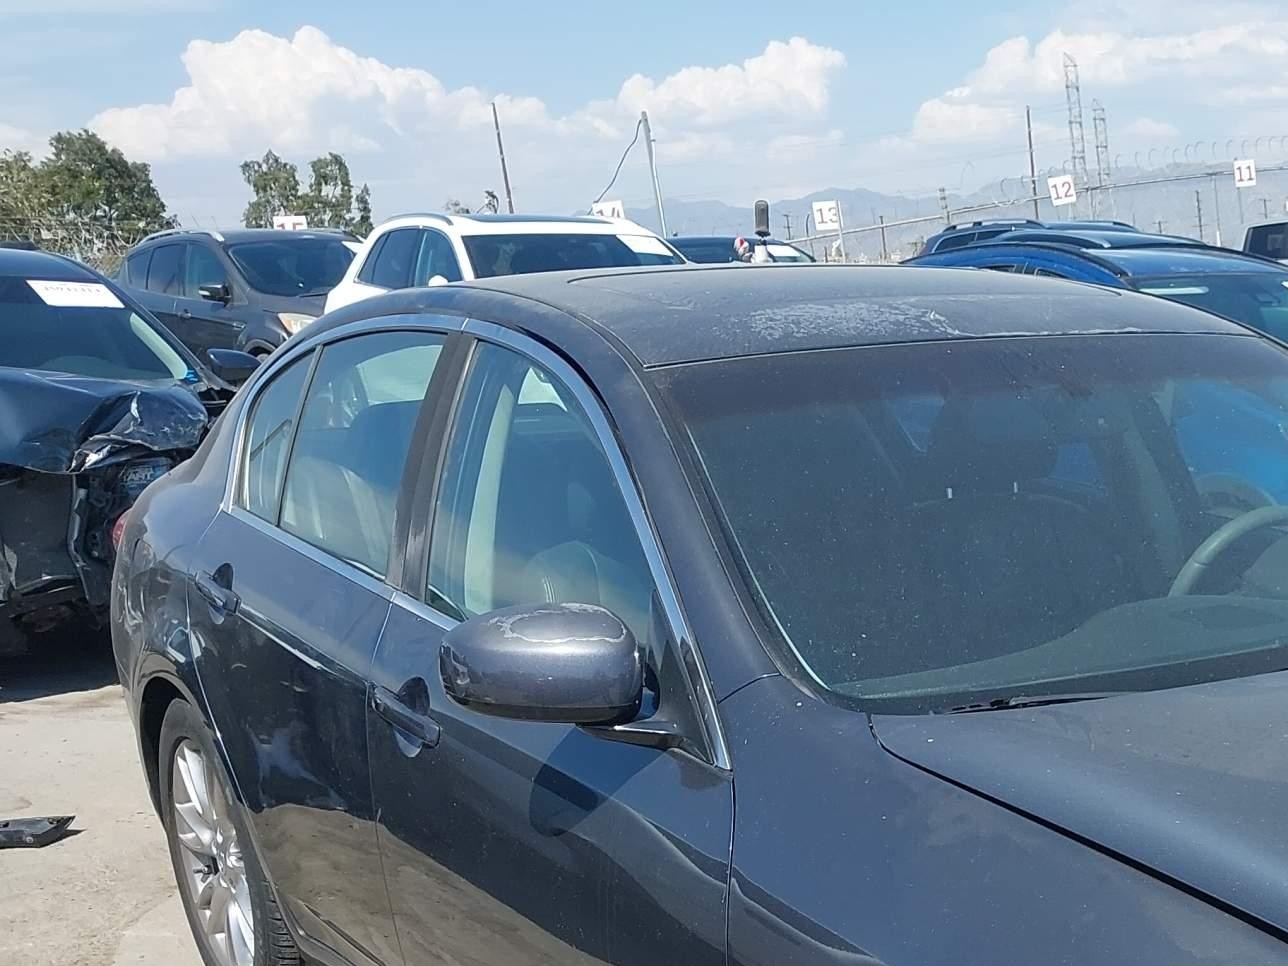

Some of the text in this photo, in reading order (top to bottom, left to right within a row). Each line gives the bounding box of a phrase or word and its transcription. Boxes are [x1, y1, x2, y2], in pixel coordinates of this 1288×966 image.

[1235, 165, 1255, 182] 11
[1050, 181, 1074, 200] 12
[815, 206, 839, 225] 13
